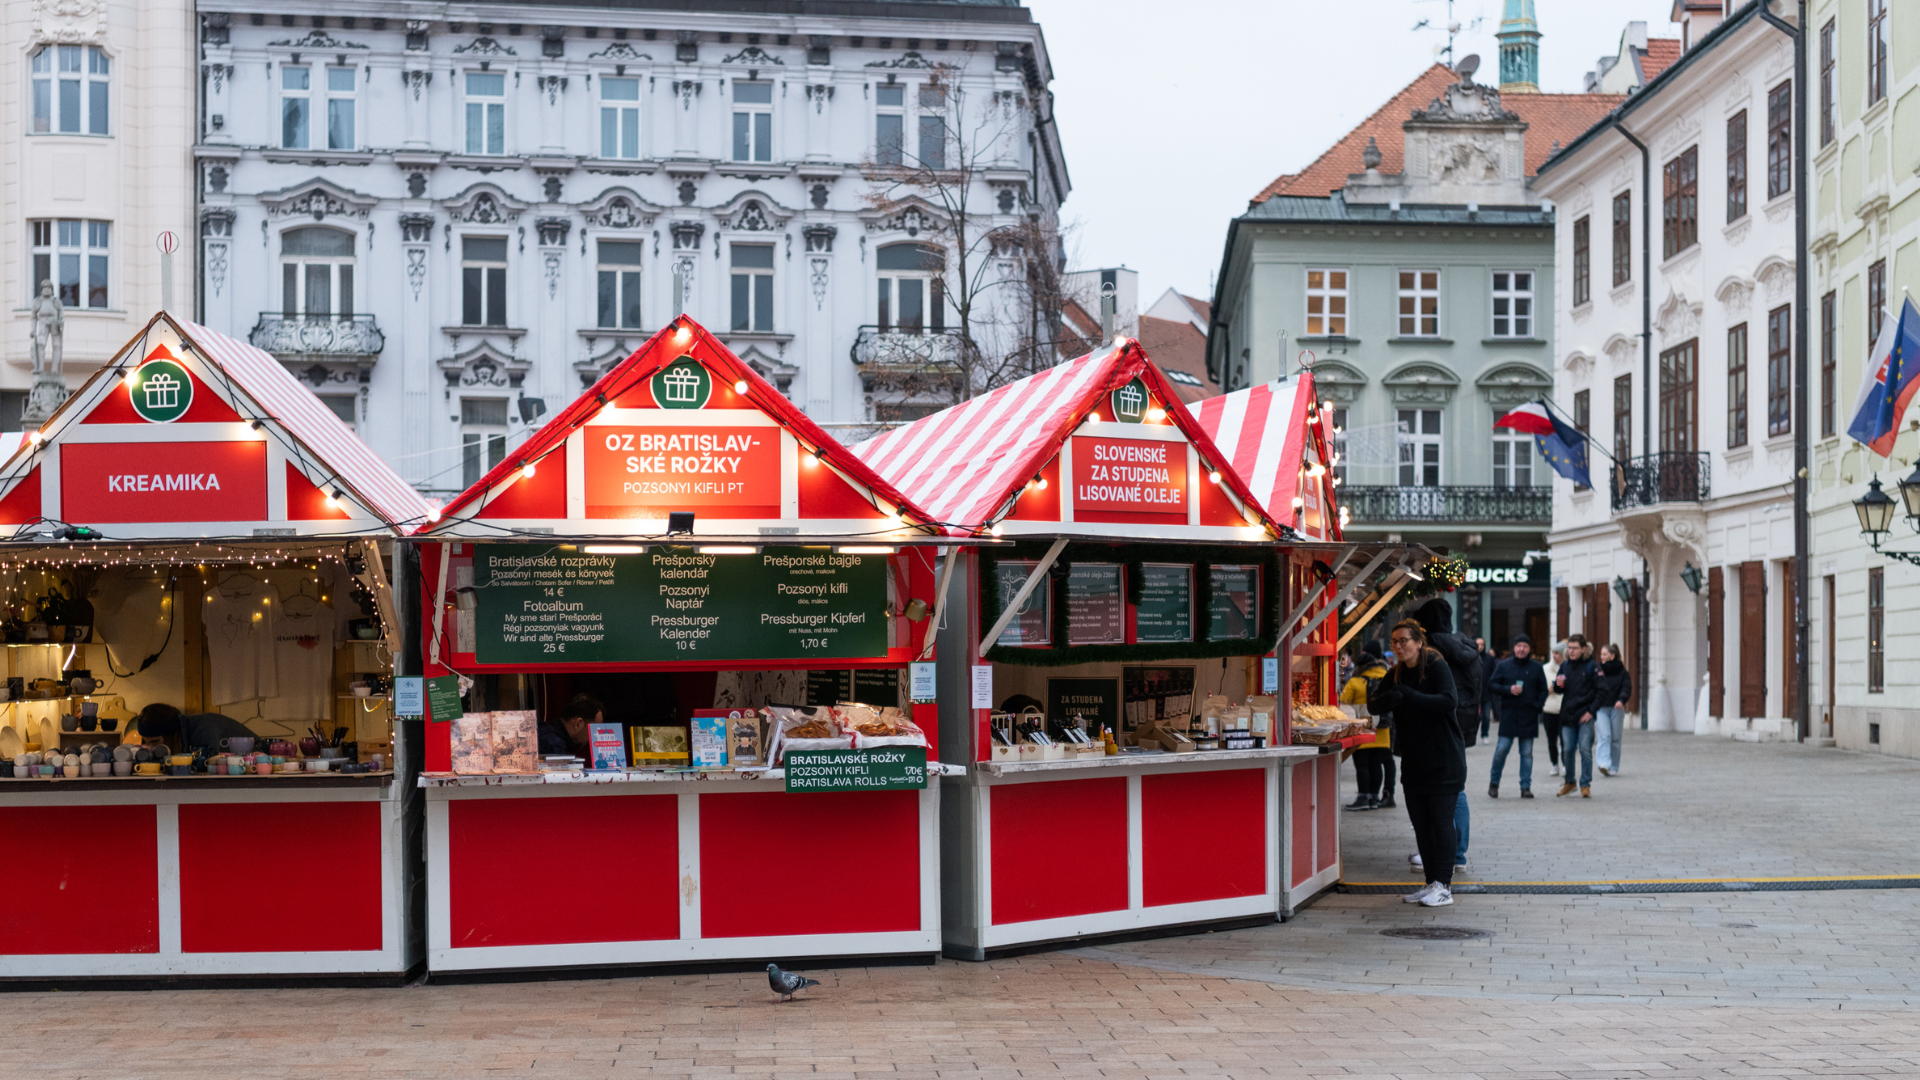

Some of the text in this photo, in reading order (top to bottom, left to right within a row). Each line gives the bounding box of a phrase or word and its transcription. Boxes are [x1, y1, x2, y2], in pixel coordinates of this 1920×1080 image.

[605, 434, 760, 451] OZ BRATISLAV-
[1094, 444, 1166, 463] SLOVENSKÉ
[626, 452, 741, 473] SKÉ ROŽKY
[1091, 465, 1170, 483] ZA STUDENA
[109, 474, 220, 492] KREAMIKA
[624, 483, 744, 494] POZSONYI KIFLI PT
[1080, 483, 1181, 504] LISOVANÉ OLEJE
[489, 556, 616, 569] Bratislavské rozprávky
[652, 554, 716, 568] Prešporský
[763, 555, 861, 568] Prešporské bajgle
[491, 569, 614, 580] Pozsonyi mesék és könyvek
[660, 567, 709, 579] kalendár
[1465, 568, 1529, 583] BUCKS
[543, 587, 564, 597] 14 €
[659, 584, 710, 598] Pozsonyi
[777, 583, 848, 596] Pozsonyi kifli
[523, 600, 584, 612] Fotoalbum
[666, 598, 704, 611] Naptár
[504, 614, 518, 623] My
[559, 613, 602, 623] Prešporáci
[651, 615, 719, 628] Pressburger
[760, 612, 866, 626] Pressburger Kipferl
[503, 623, 604, 633] Régi pozsonyiak vagyunk
[660, 628, 711, 639] Kalender
[503, 633, 604, 643] Wir sind alte Pressburger
[800, 638, 828, 649] 1,70 €
[543, 643, 565, 653] 25 €
[675, 640, 696, 650] 10 €
[1061, 695, 1103, 704] ZA STUDENA
[1065, 706, 1099, 716] LISOVANÉ
[790, 752, 906, 765] BRATISLAVSKÉ ROŽKY
[790, 766, 869, 776] POZSONYI KIFLI
[790, 776, 887, 788] BRATISLAVA ROLLS
